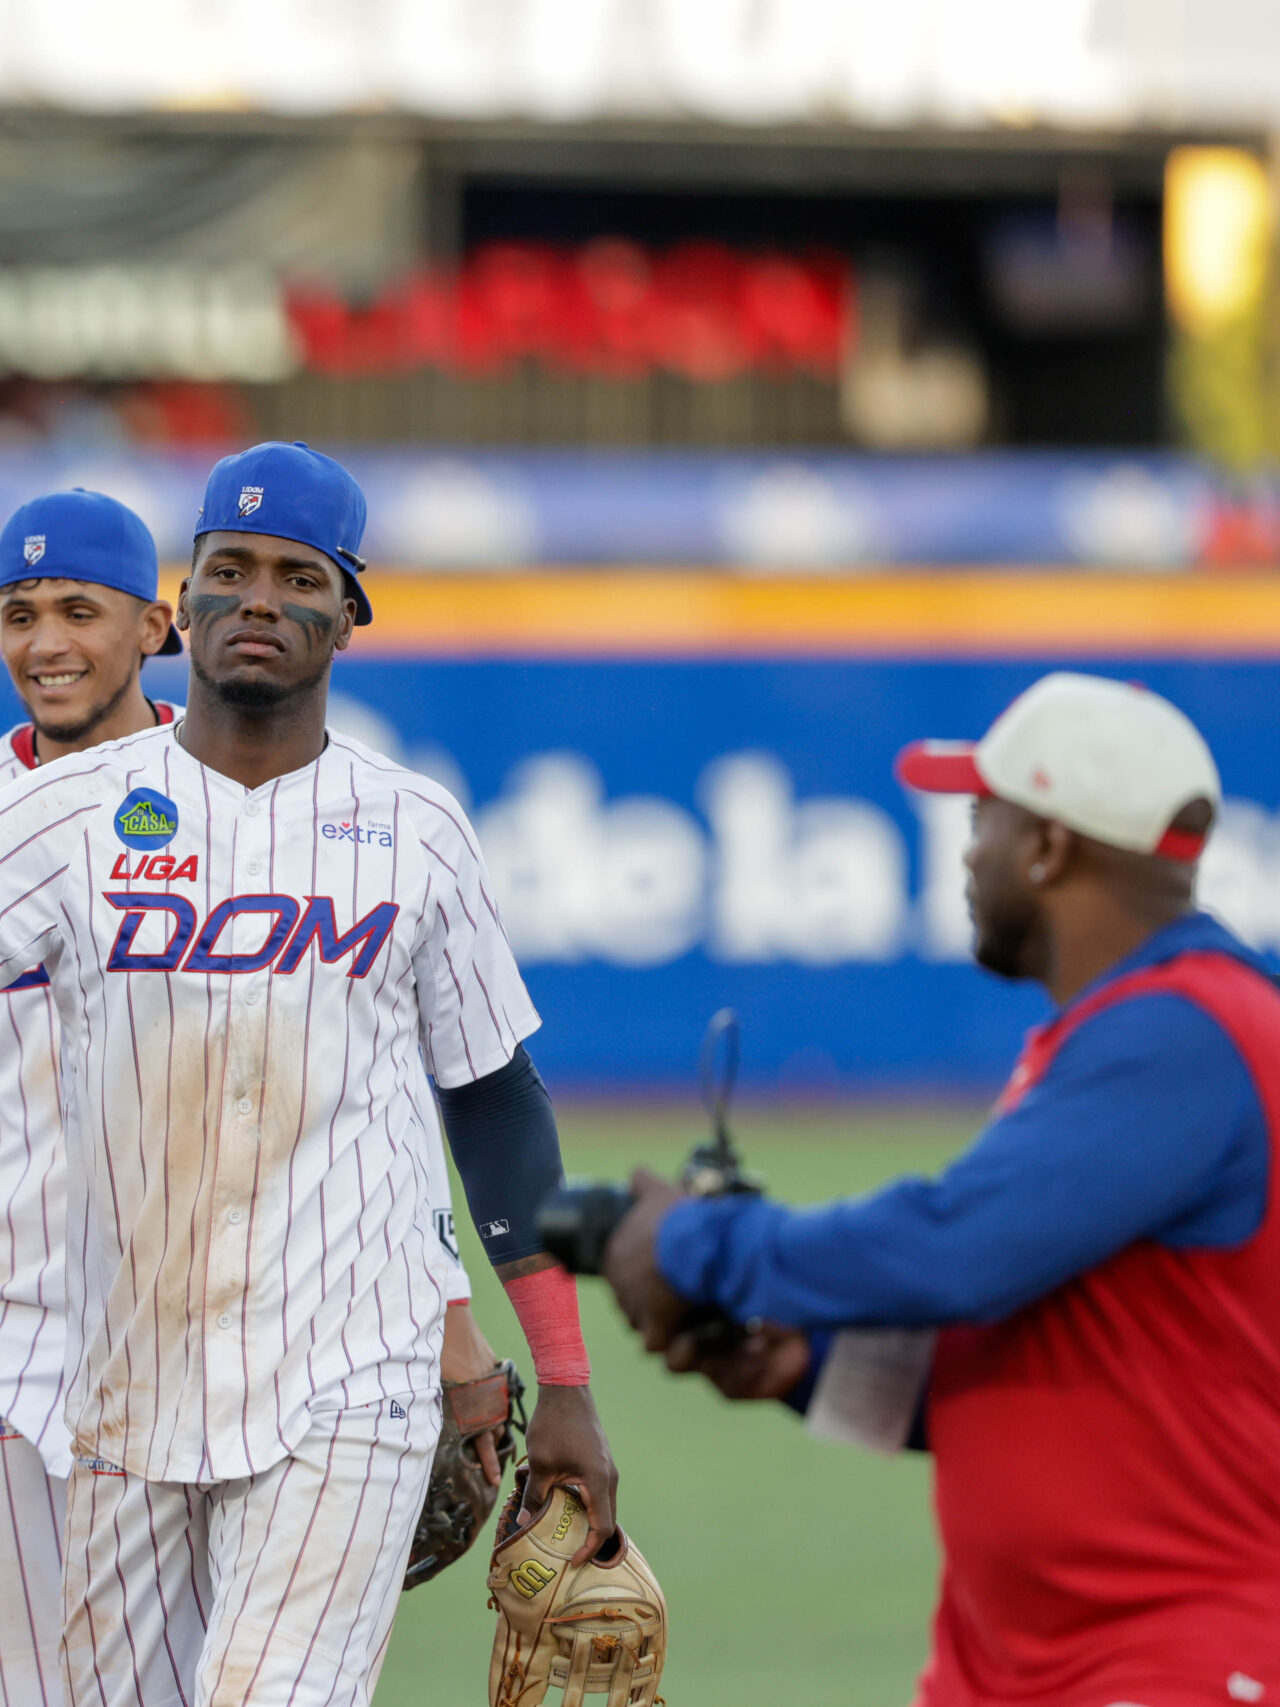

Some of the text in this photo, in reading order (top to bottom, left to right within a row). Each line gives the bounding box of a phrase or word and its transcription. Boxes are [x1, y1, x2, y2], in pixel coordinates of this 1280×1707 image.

[129, 813, 168, 831] CASA
[321, 822, 392, 848] extra
[367, 820, 391, 830] farma
[109, 853, 198, 882] LIGA
[702, 750, 908, 964] la
[101, 891, 400, 978] DOM
